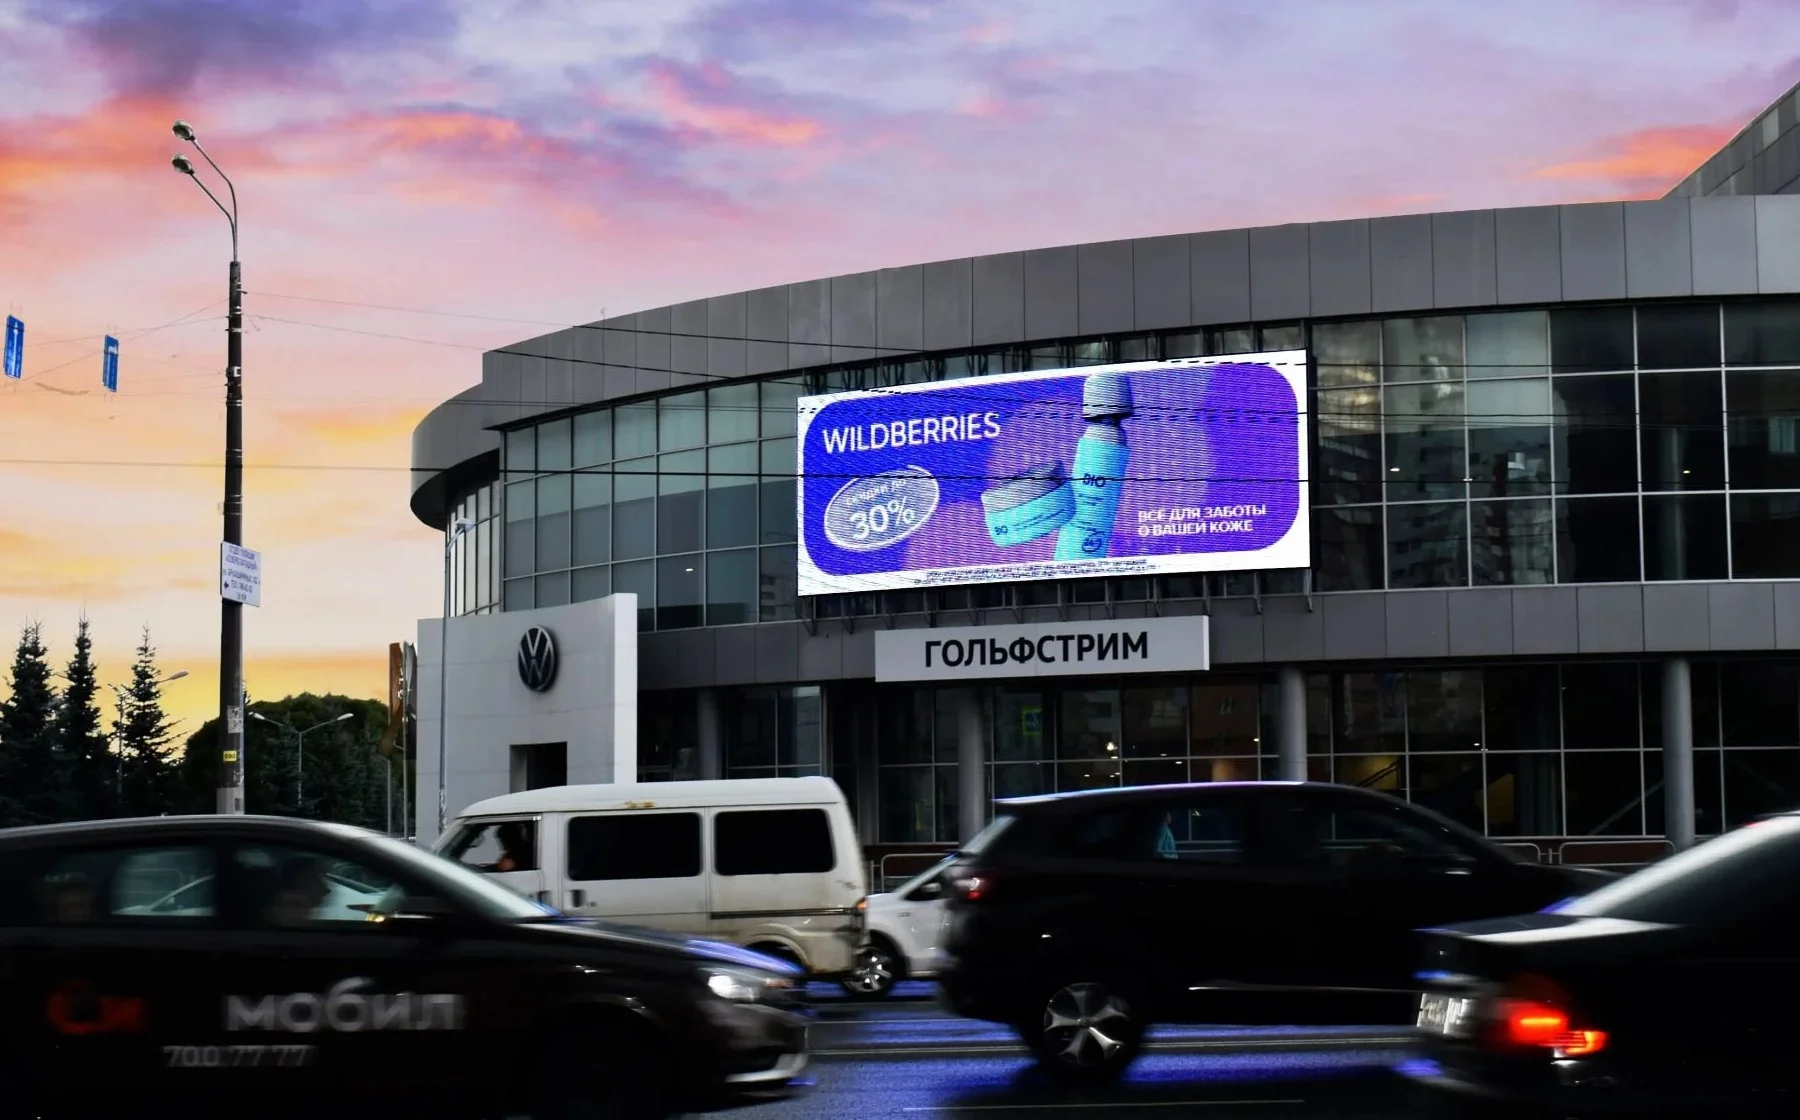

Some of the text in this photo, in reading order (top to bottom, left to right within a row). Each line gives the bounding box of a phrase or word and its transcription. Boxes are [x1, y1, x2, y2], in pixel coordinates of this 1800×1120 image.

[822, 412, 1001, 455] WILDBERRIES
[848, 496, 915, 540] 30%
[1138, 519, 1254, 537] О ВАШЕЙ КОЖЕ
[1170, 507, 1201, 521] ДЛЯ
[1203, 503, 1267, 519] ЗАБОТЫ
[925, 631, 1149, 669] ГОЛЬФСТРИМ
